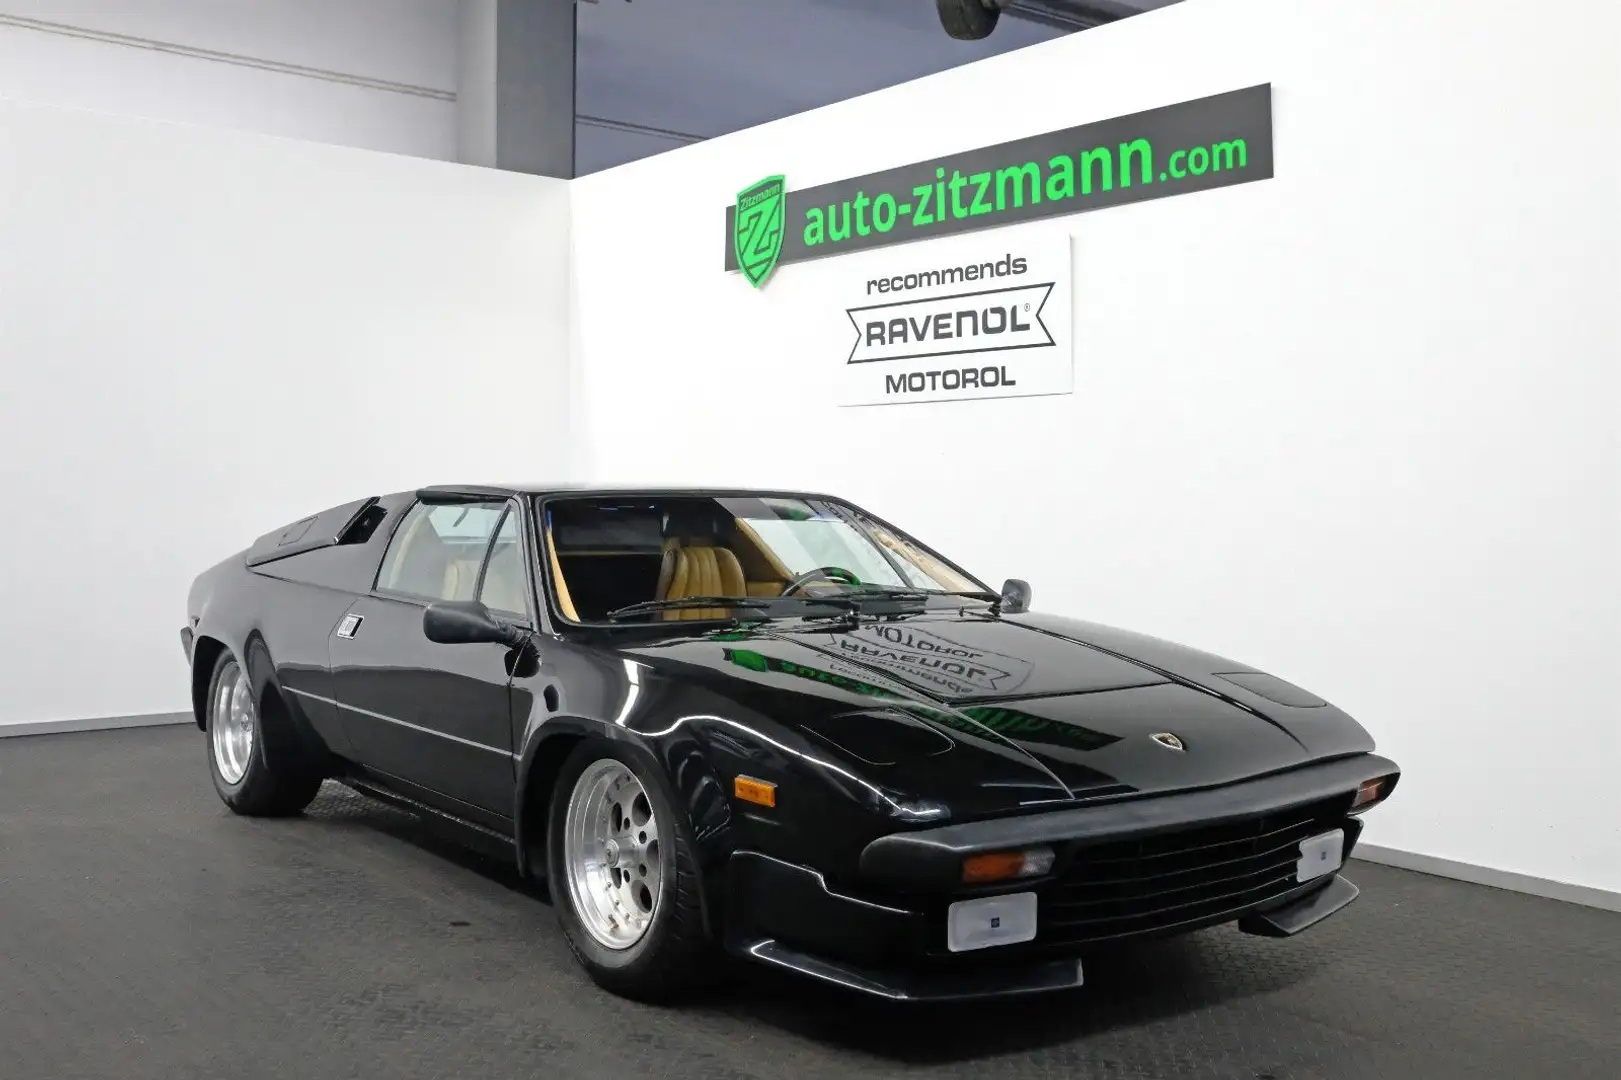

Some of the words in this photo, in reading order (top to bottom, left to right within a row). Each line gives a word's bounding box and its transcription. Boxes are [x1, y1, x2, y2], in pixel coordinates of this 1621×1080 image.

[740, 183, 781, 211] Zitzmann
[803, 137, 1248, 247] auto-zitzmann.com
[866, 253, 1028, 295] recommends
[866, 304, 1031, 347] RAVENOL
[885, 365, 1017, 394] MOTOROL
